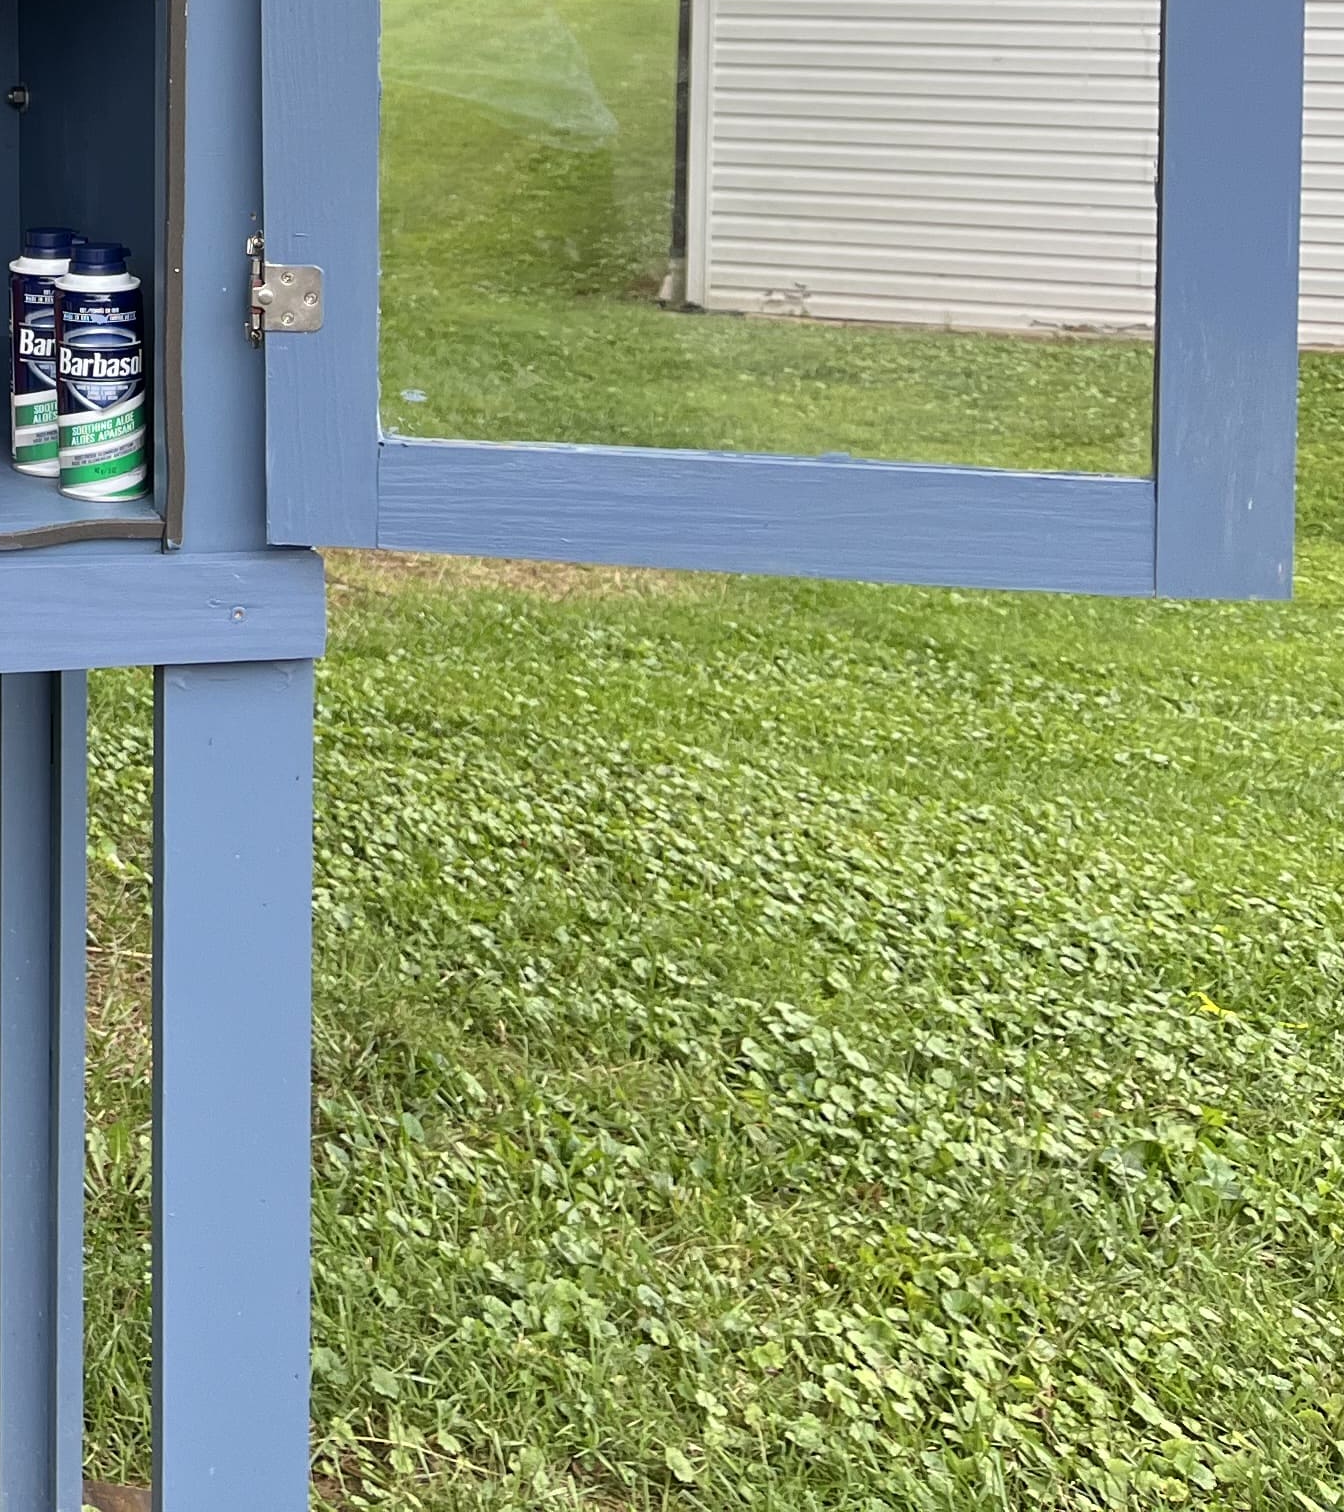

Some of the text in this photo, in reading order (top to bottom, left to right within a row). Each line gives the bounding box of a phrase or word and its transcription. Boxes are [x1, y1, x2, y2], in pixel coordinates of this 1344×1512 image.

[59, 347, 142, 377] Barbasol
[71, 411, 135, 436] SOOTHING ALOE
